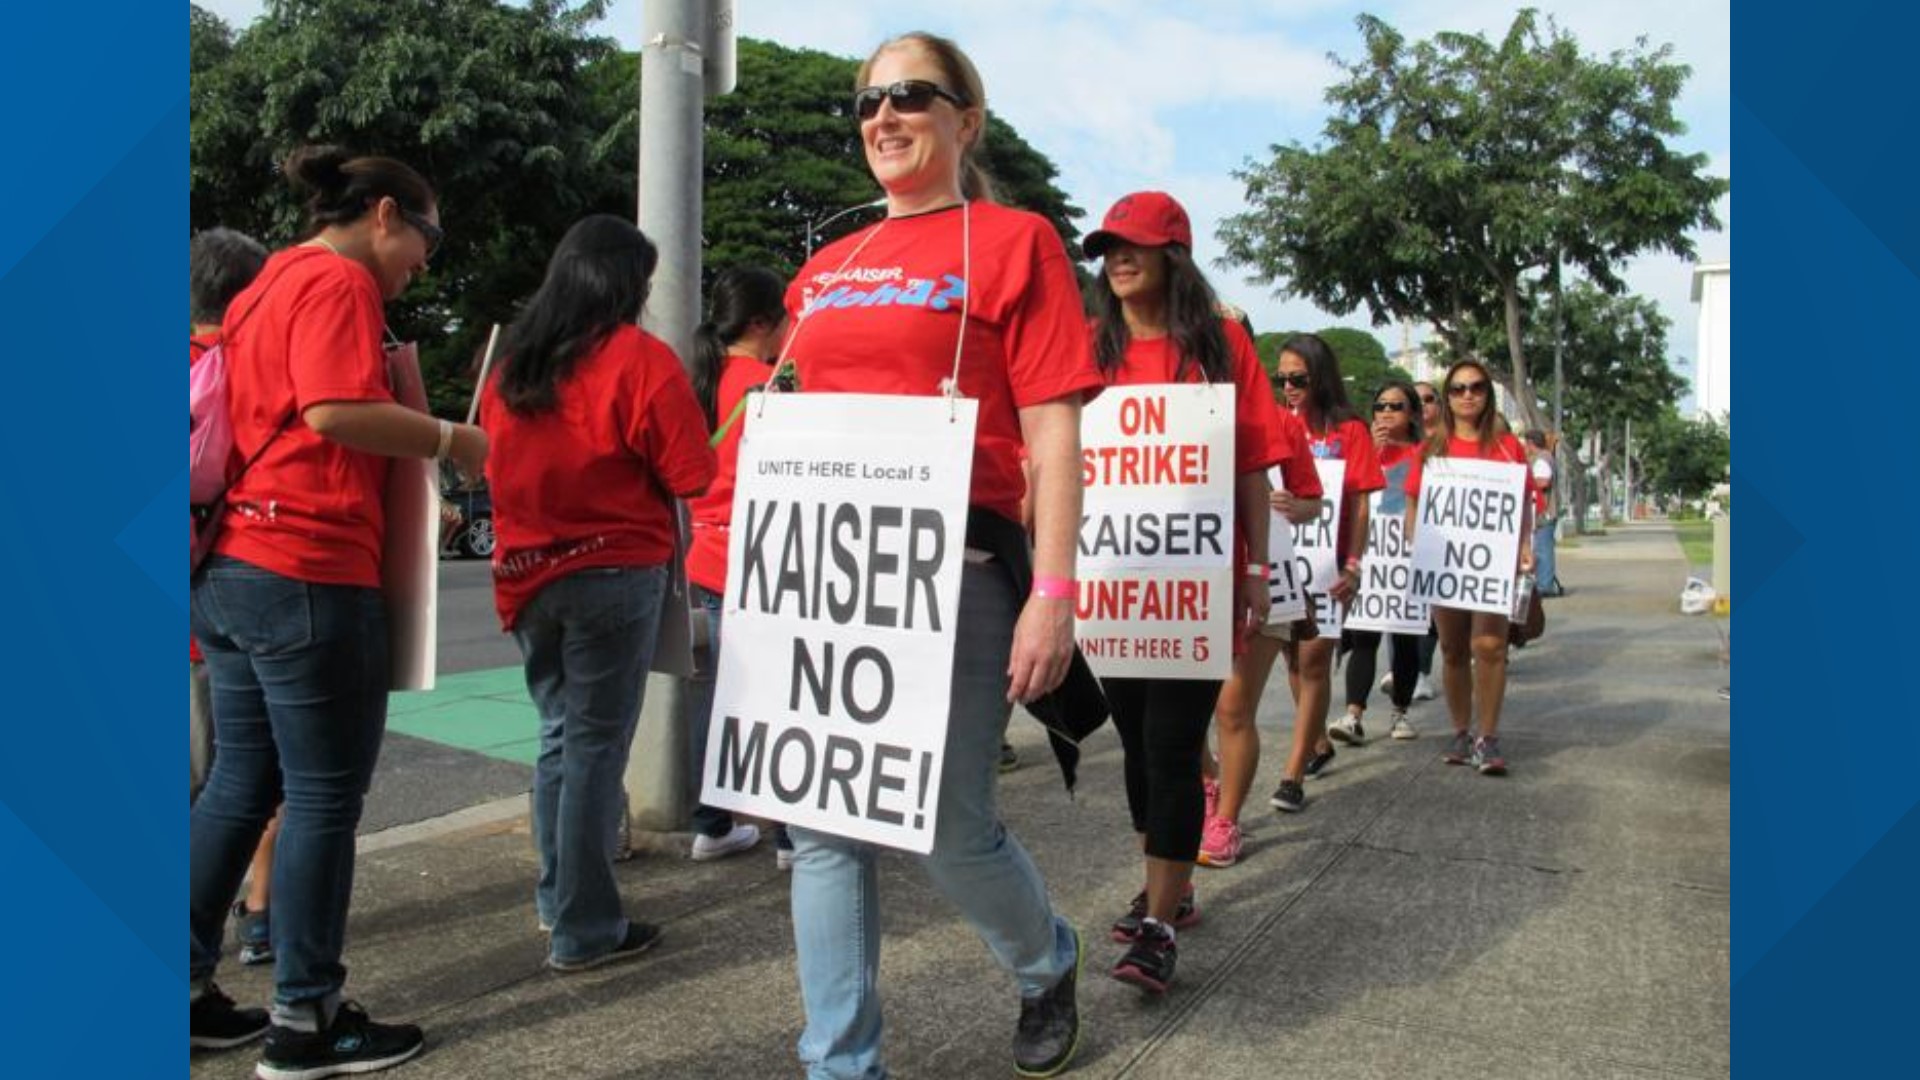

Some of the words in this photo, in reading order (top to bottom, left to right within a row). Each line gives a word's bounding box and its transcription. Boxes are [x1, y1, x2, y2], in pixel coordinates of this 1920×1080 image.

[1120, 396, 1166, 436] ON
[758, 460, 802, 477] UNITE
[808, 460, 856, 478] HERE
[863, 464, 913, 480] Local
[919, 466, 931, 481] 5
[1081, 445, 1209, 487] STRIKE!
[1424, 486, 1516, 533] KAISER
[739, 499, 946, 632] KAISER
[1444, 541, 1492, 571] NO
[1370, 564, 1409, 591] NO
[1412, 569, 1509, 605] MORE!
[1075, 580, 1209, 621] UNFAIR!
[1134, 638, 1182, 660] HERE
[1192, 636, 1209, 662] 5
[789, 637, 895, 725] NO
[716, 716, 933, 830] MORE!
